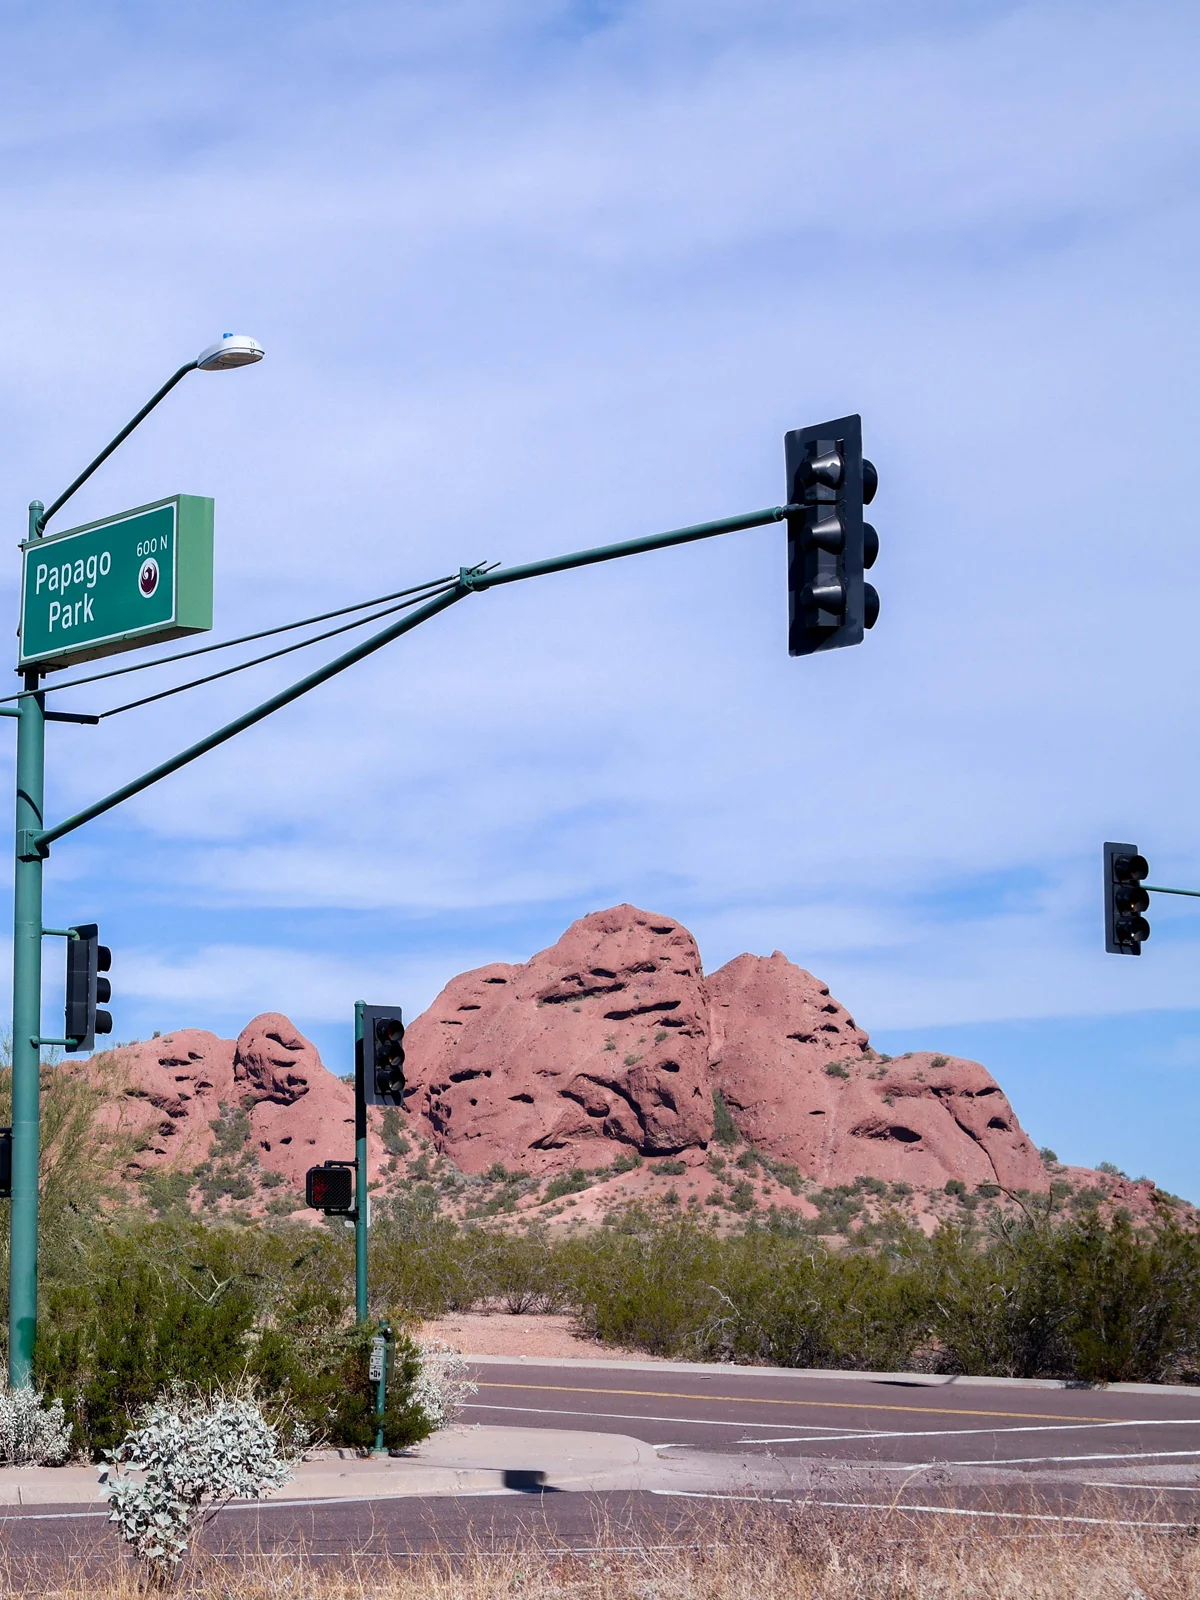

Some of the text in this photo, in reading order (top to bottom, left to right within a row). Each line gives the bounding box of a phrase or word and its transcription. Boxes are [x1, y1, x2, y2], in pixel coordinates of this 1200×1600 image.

[136, 535, 168, 557] 600 N
[36, 551, 111, 595] Papago
[49, 593, 94, 632] Park
